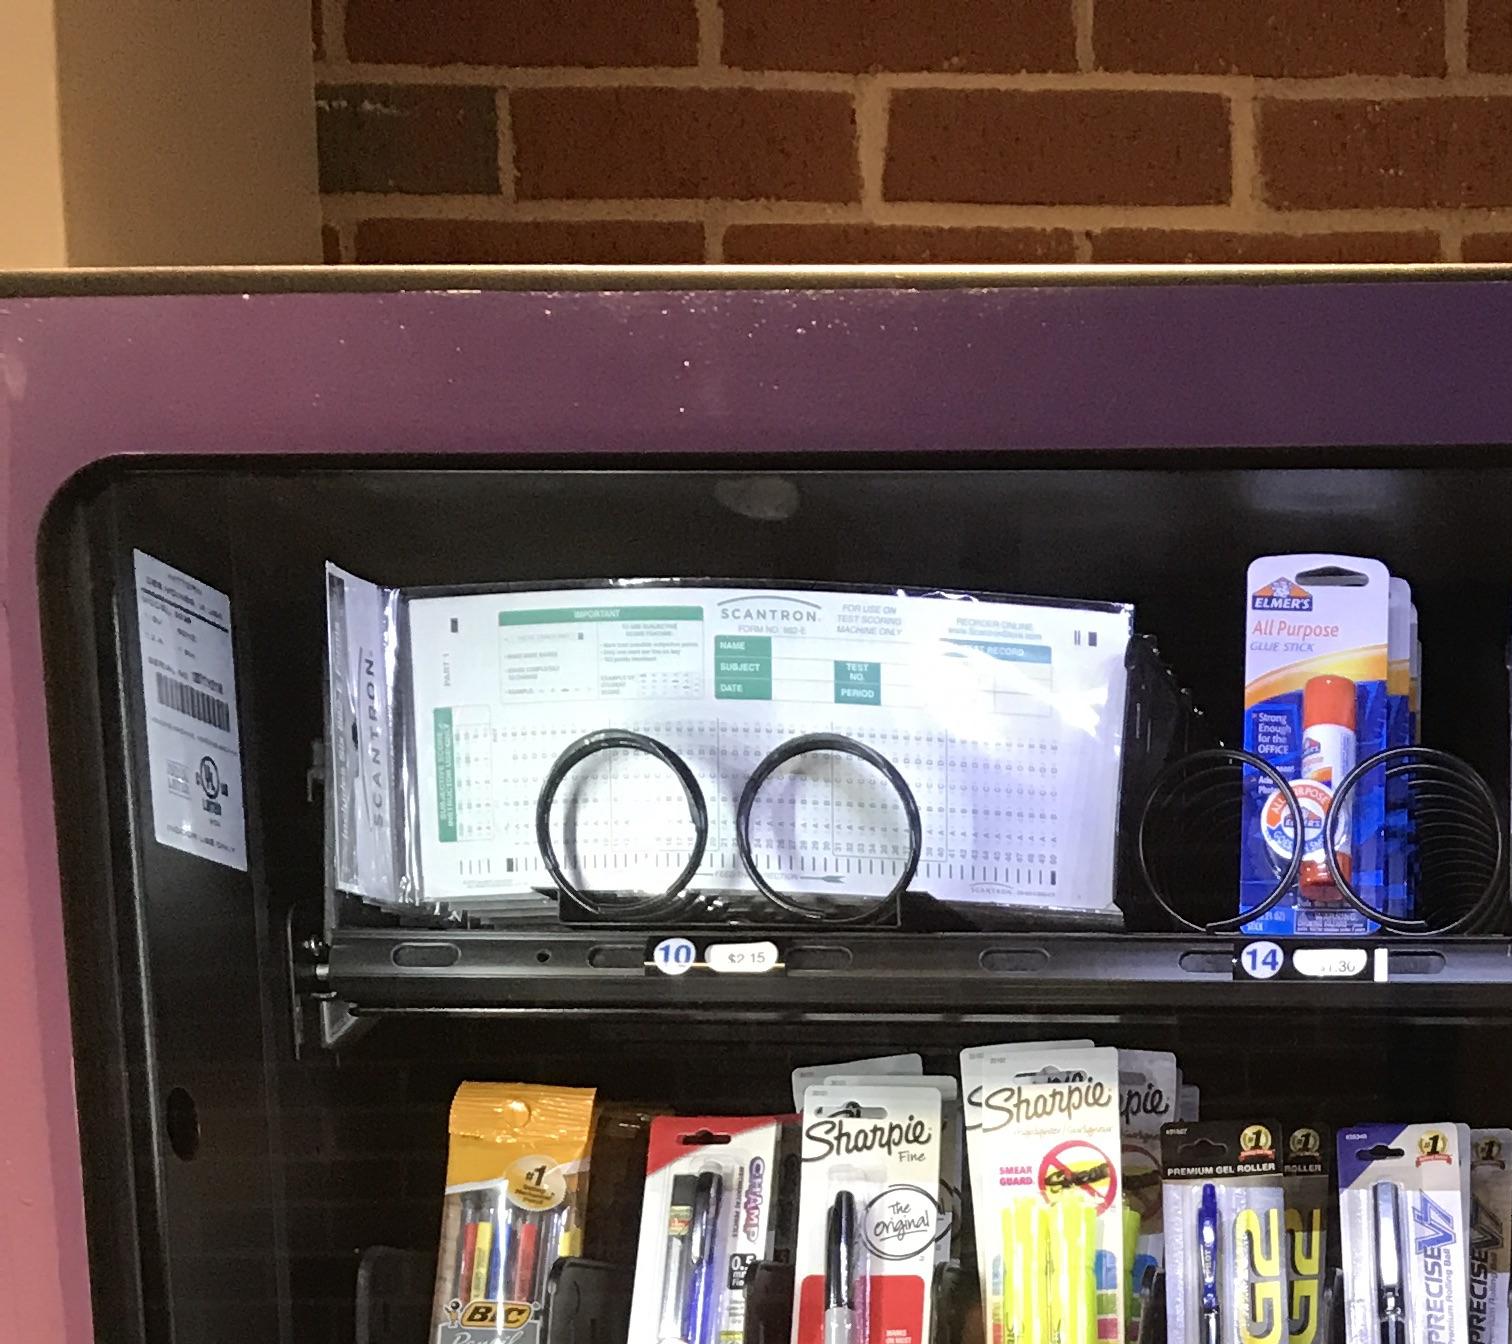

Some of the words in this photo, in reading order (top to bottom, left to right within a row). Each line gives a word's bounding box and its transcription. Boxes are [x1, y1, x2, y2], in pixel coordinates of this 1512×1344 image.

[721, 608, 817, 622] SCANTRON
[1253, 597, 1312, 611] ELMER'S
[1252, 620, 1275, 636] All
[1277, 621, 1339, 639] Purpose
[1246, 948, 1280, 974] 14
[981, 1081, 1112, 1134] Sharpie
[801, 1115, 932, 1163] Sharpie
[889, 1201, 911, 1217] The
[874, 1215, 930, 1241] original
